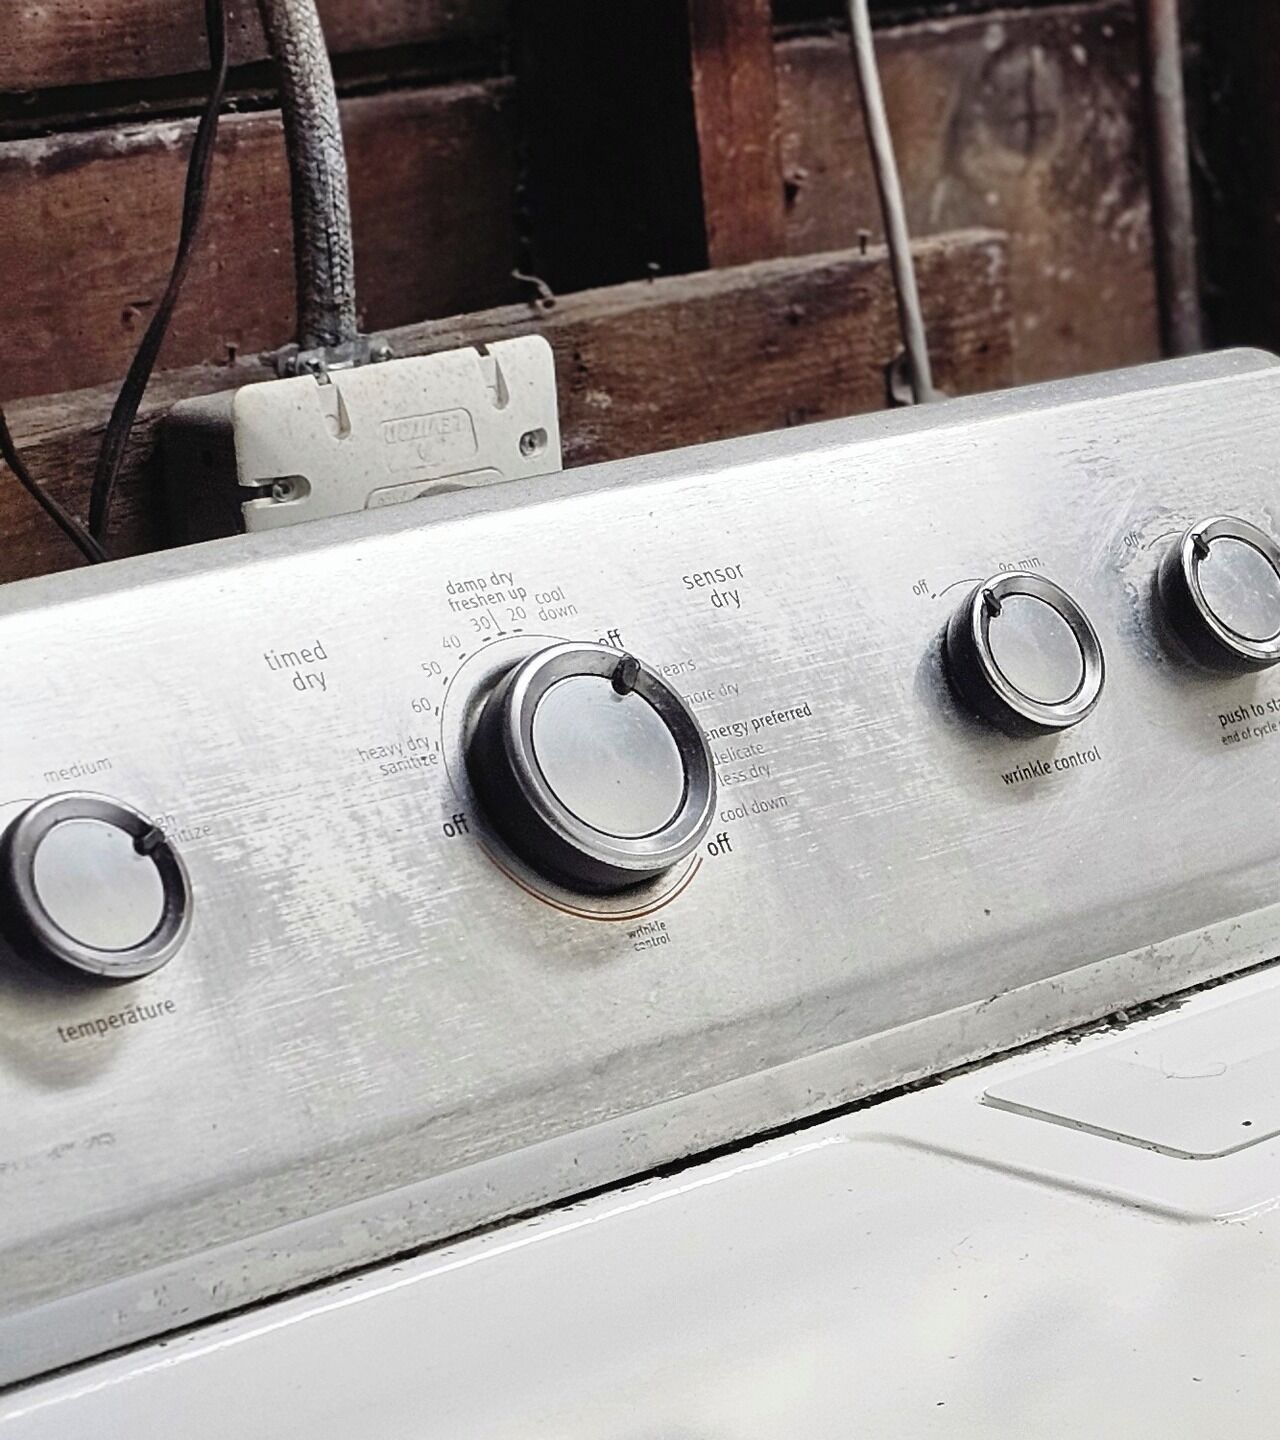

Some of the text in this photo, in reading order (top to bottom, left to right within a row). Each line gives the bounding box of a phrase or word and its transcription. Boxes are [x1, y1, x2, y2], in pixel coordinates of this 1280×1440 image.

[1123, 531, 1139, 548] off
[446, 571, 515, 596] damp dry
[682, 563, 744, 591] sensor
[912, 579, 929, 596] off
[448, 586, 528, 613] freshen up
[535, 586, 566, 605] cool
[710, 589, 742, 609] dry
[506, 606, 527, 622] 20
[538, 602, 578, 622] down
[470, 615, 491, 633] 30
[442, 634, 461, 649] 40
[598, 628, 625, 648] off
[263, 639, 328, 671] timed
[421, 660, 442, 678] 50
[292, 671, 327, 692] dry
[719, 681, 740, 698] dry
[411, 697, 431, 713] 60
[1217, 705, 1251, 730] push
[1250, 703, 1265, 717] to
[705, 702, 813, 743] energy preferred
[1221, 730, 1241, 746] end
[1241, 727, 1252, 740] of
[1253, 720, 1279, 739] cycle
[356, 735, 430, 763] heavy dry
[43, 757, 113, 784] medium
[379, 752, 439, 777] sanitize
[718, 764, 771, 787] less dry
[1001, 745, 1102, 785] wrinkle control
[720, 795, 789, 823] cool down
[442, 813, 470, 838] off
[706, 831, 733, 857] off
[626, 920, 667, 939] wrinkle
[633, 932, 672, 952] control
[56, 999, 177, 1043] temperature
